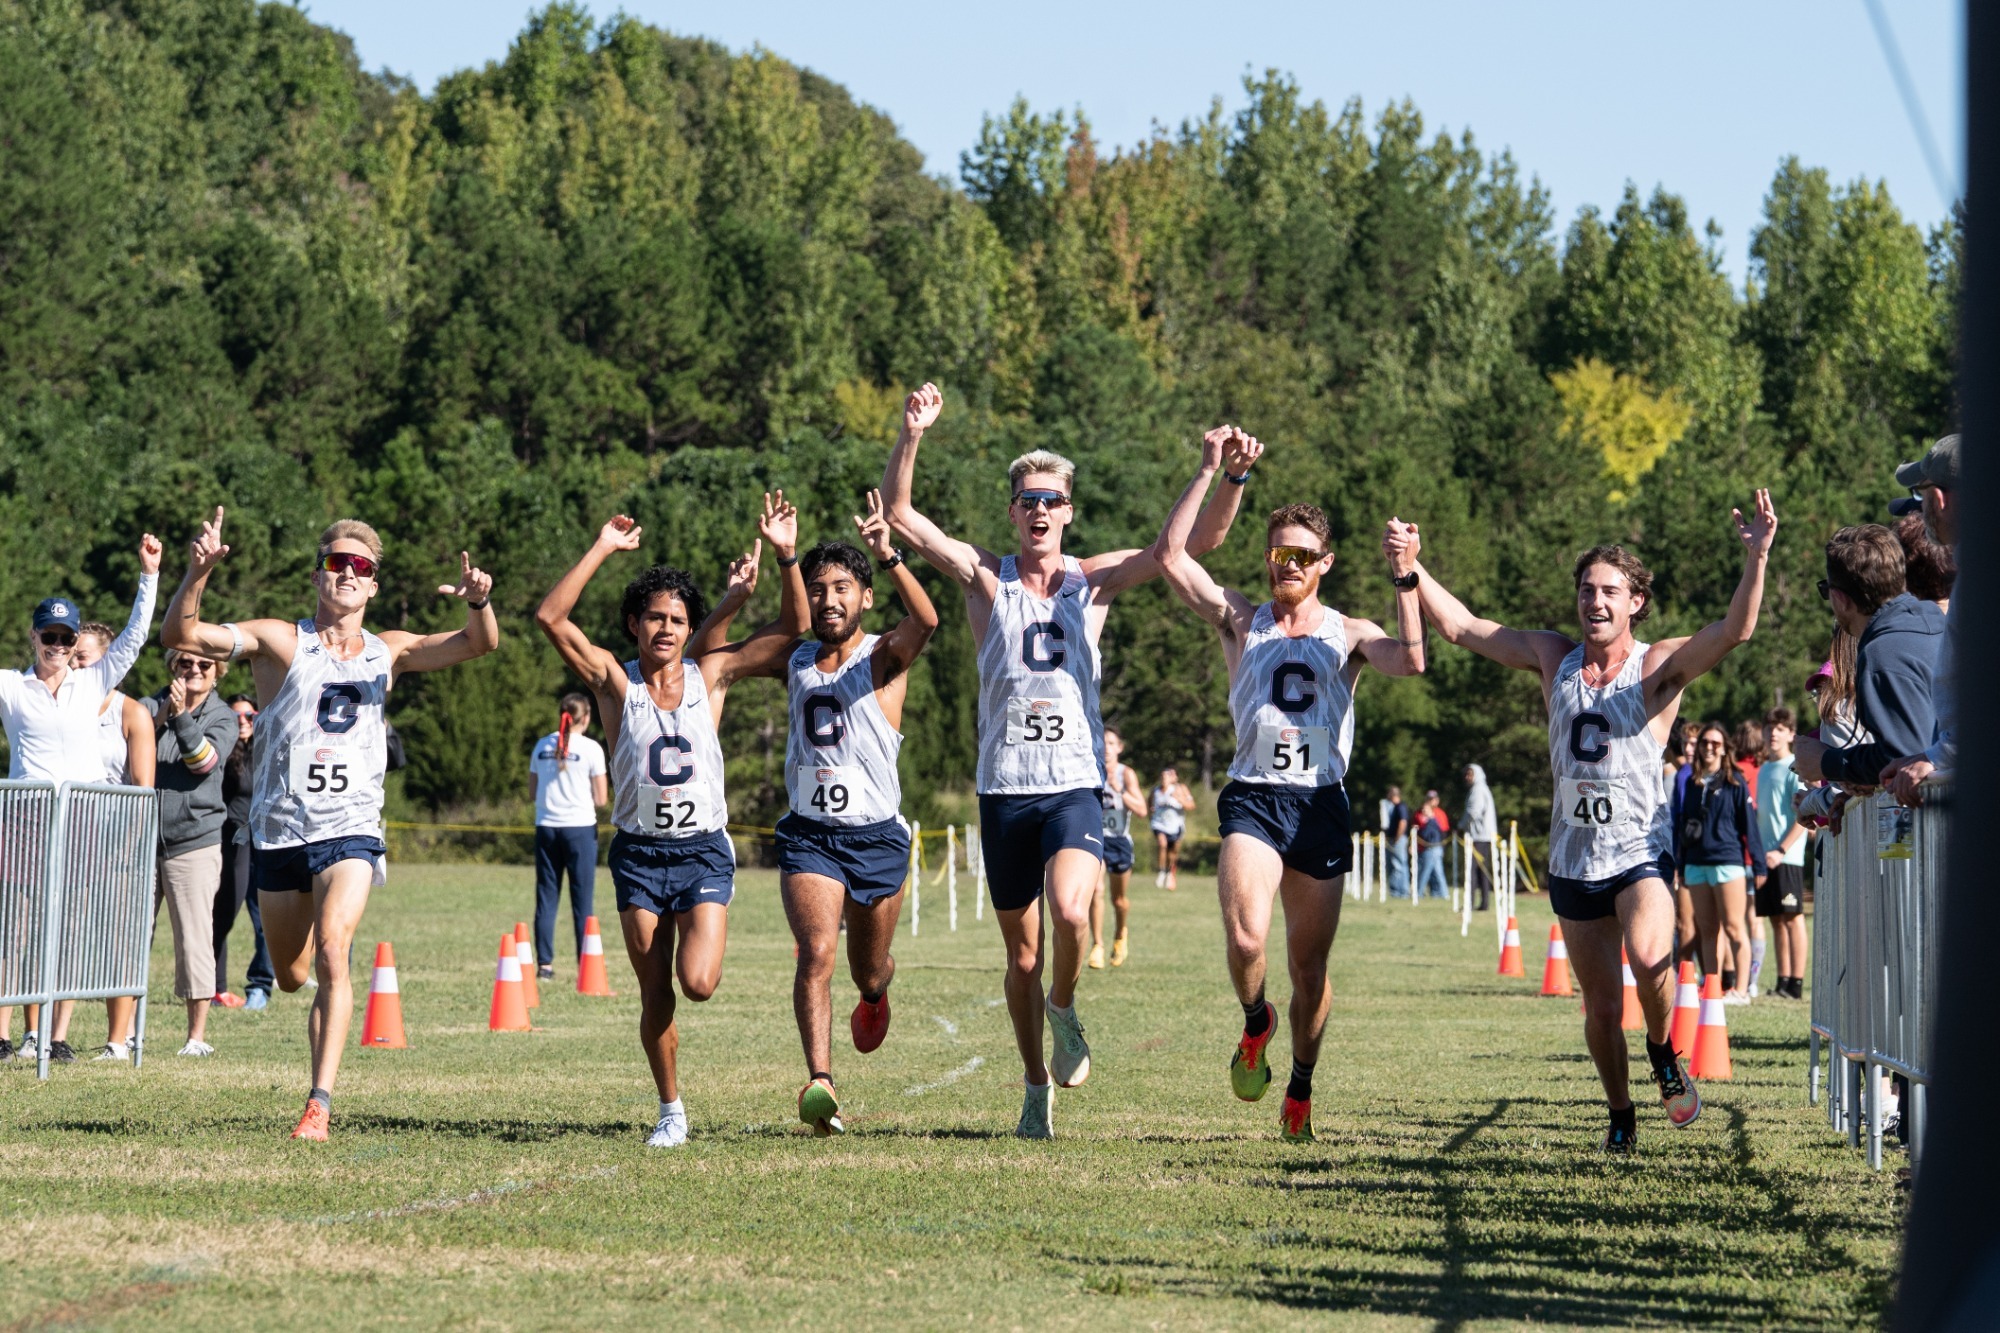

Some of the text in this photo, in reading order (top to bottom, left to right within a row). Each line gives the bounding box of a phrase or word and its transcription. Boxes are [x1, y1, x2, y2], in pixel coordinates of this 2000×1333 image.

[1021, 620, 1066, 675] C
[1270, 660, 1318, 715] C
[314, 682, 362, 736] C
[803, 692, 846, 749] C
[1023, 714, 1065, 742] 53
[1272, 743, 1310, 771] 51
[1569, 710, 1613, 765] C
[306, 763, 349, 793] 55
[646, 733, 696, 787] C
[654, 800, 698, 830] 52
[810, 784, 849, 813] 49
[1573, 797, 1613, 825] 40
